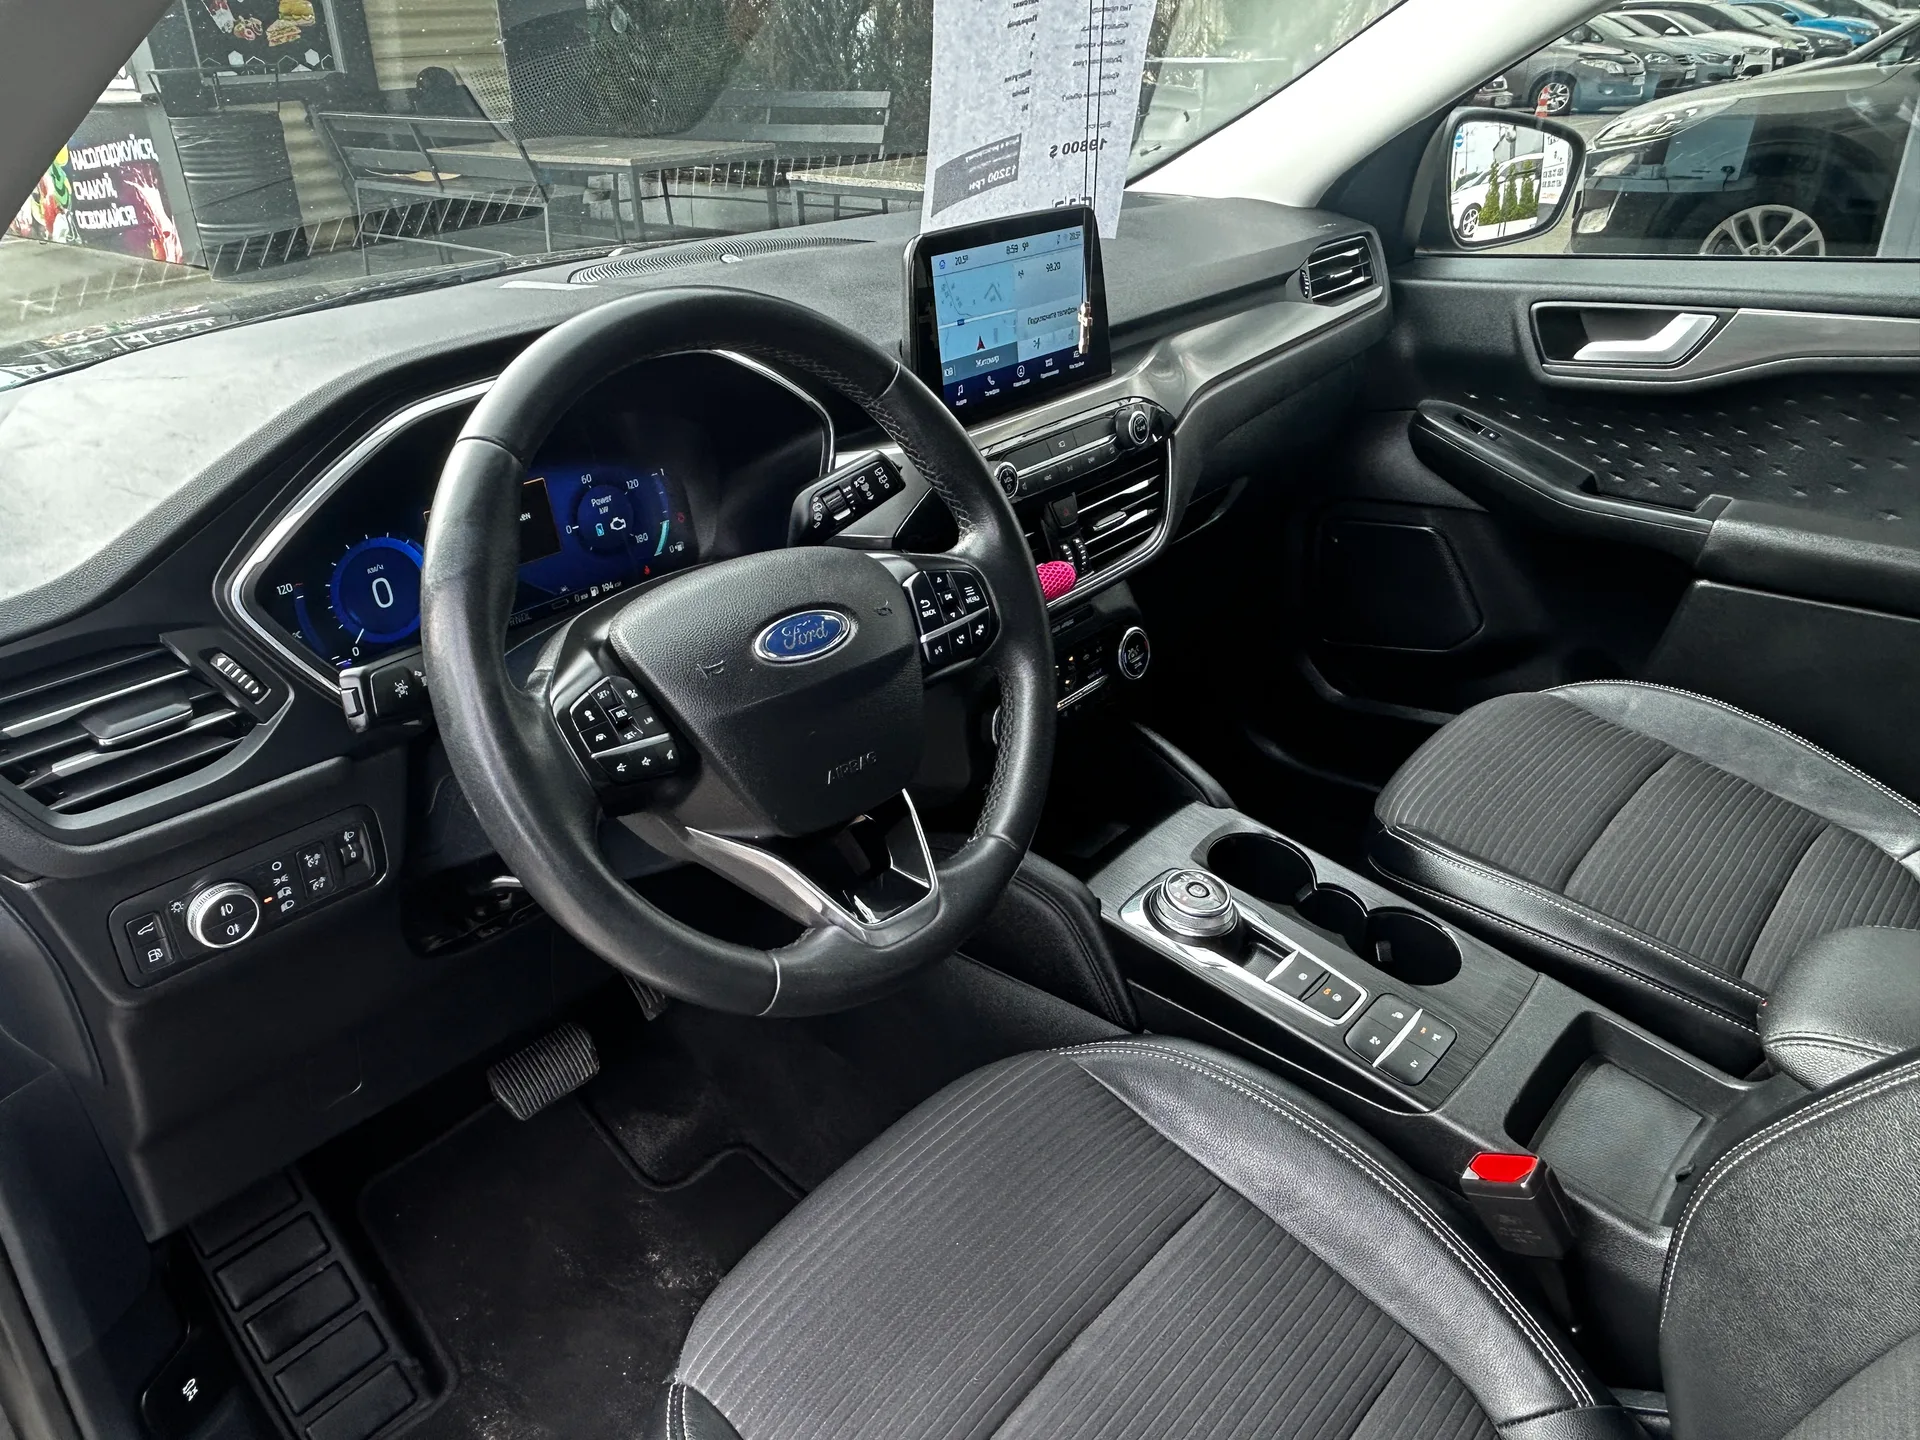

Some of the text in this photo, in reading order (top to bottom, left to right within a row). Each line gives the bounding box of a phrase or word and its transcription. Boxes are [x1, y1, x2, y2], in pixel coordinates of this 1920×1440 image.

[72, 172, 118, 201] СМАКУЙ,
[581, 473, 640, 490] 60 120
[591, 494, 612, 507] Power
[565, 524, 573, 535] 0
[276, 582, 294, 596] 120
[371, 576, 395, 609] 0
[601, 580, 614, 593] 194
[922, 608, 937, 618] BACK
[781, 619, 830, 650] Ford
[351, 646, 360, 657] 0
[826, 750, 878, 785] AIRBAG
